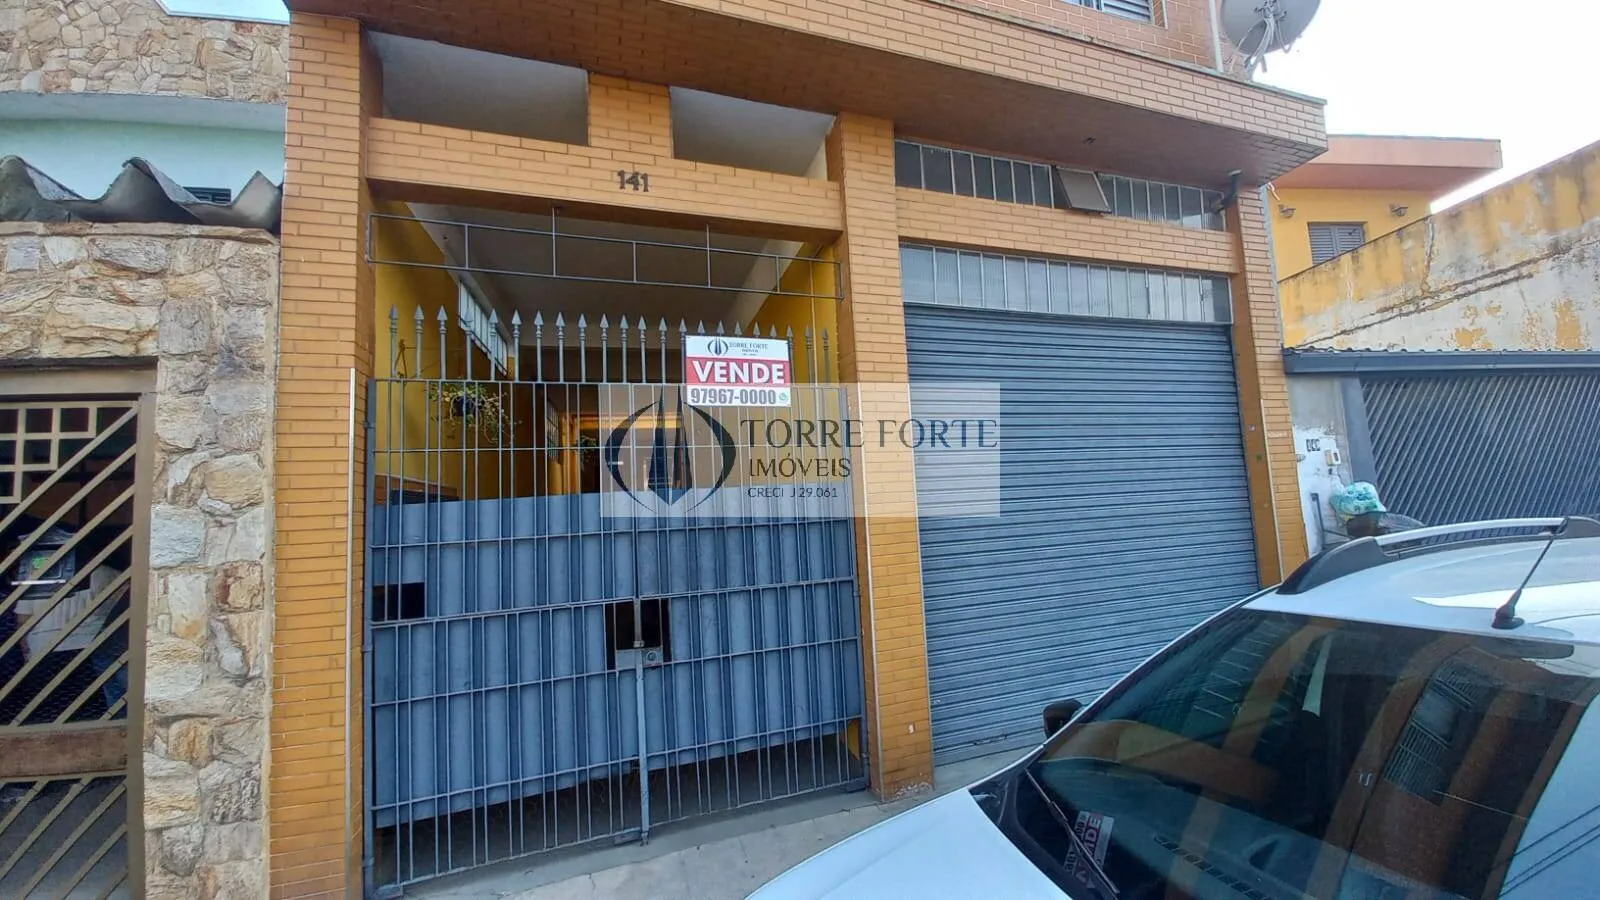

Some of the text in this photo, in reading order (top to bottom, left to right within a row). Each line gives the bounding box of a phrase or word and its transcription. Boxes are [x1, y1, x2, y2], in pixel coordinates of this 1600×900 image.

[617, 170, 649, 192] 141
[692, 360, 785, 385] VENDE
[690, 388, 776, 405] 97967-0000
